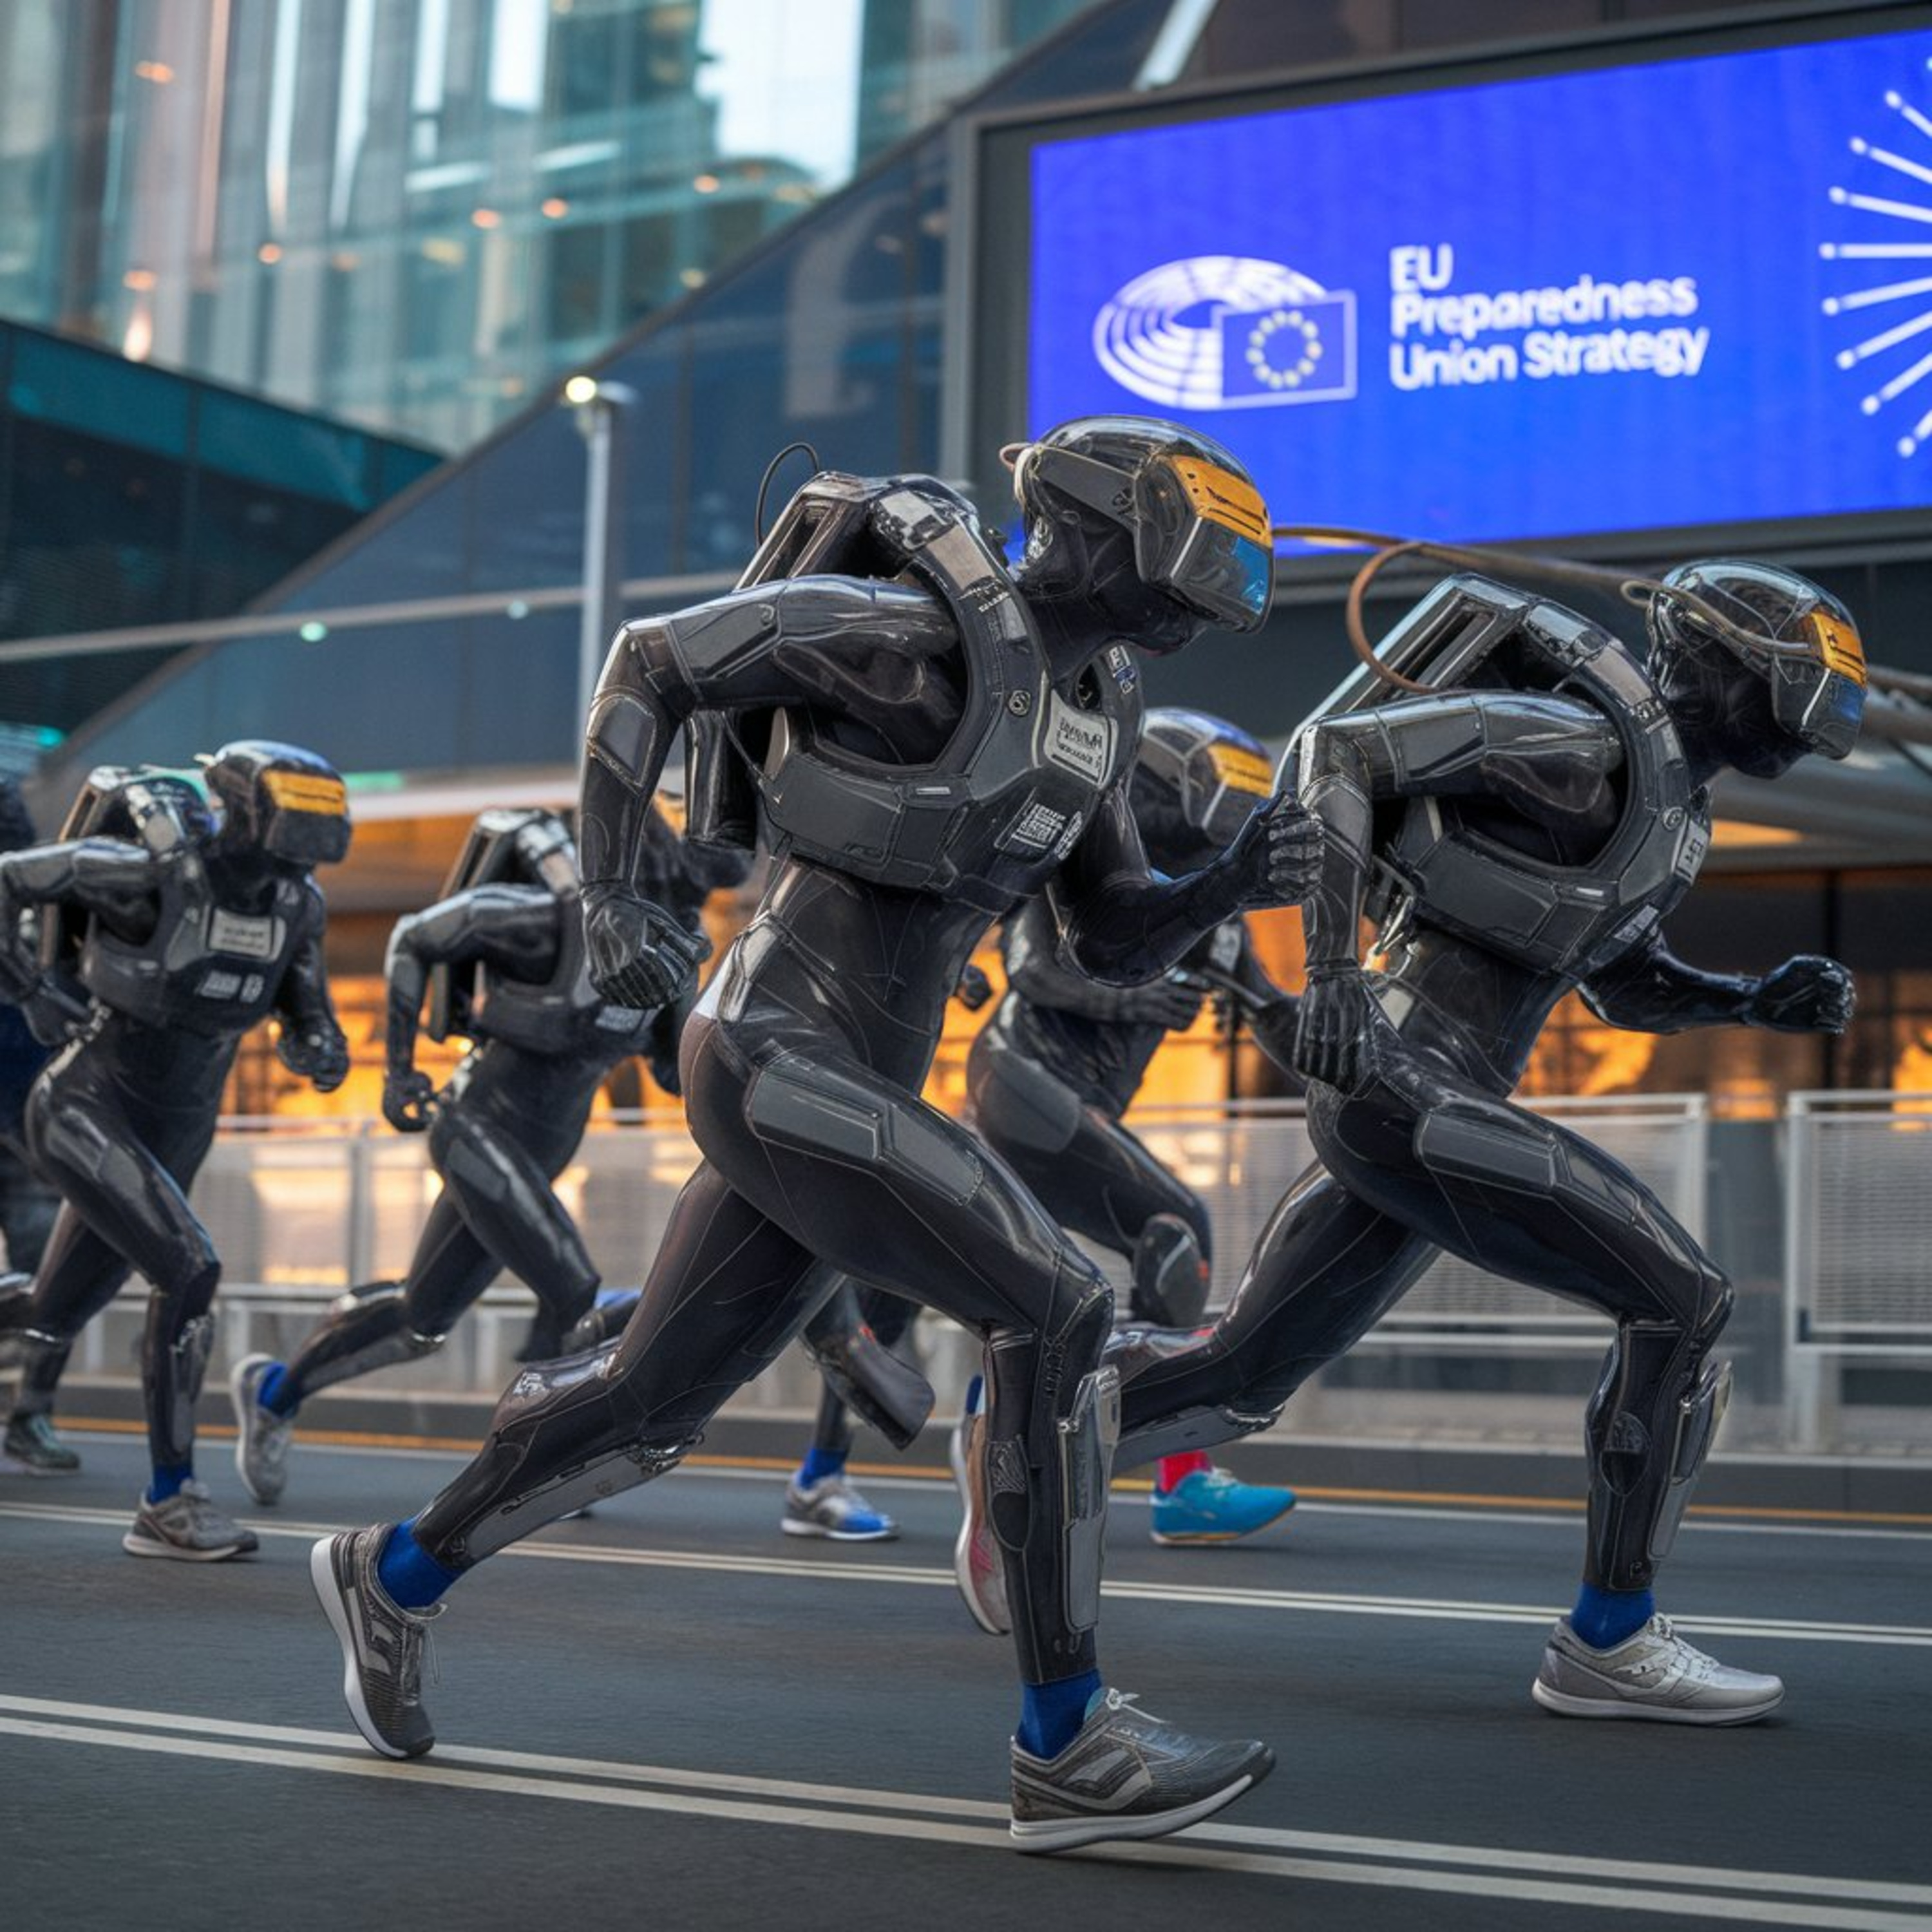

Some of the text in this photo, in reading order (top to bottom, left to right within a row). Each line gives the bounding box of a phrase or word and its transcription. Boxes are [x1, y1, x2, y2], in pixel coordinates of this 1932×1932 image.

[1390, 244, 1453, 291] EU
[1392, 274, 1698, 339] Preparedness
[1390, 327, 1709, 390] Union Strategy
